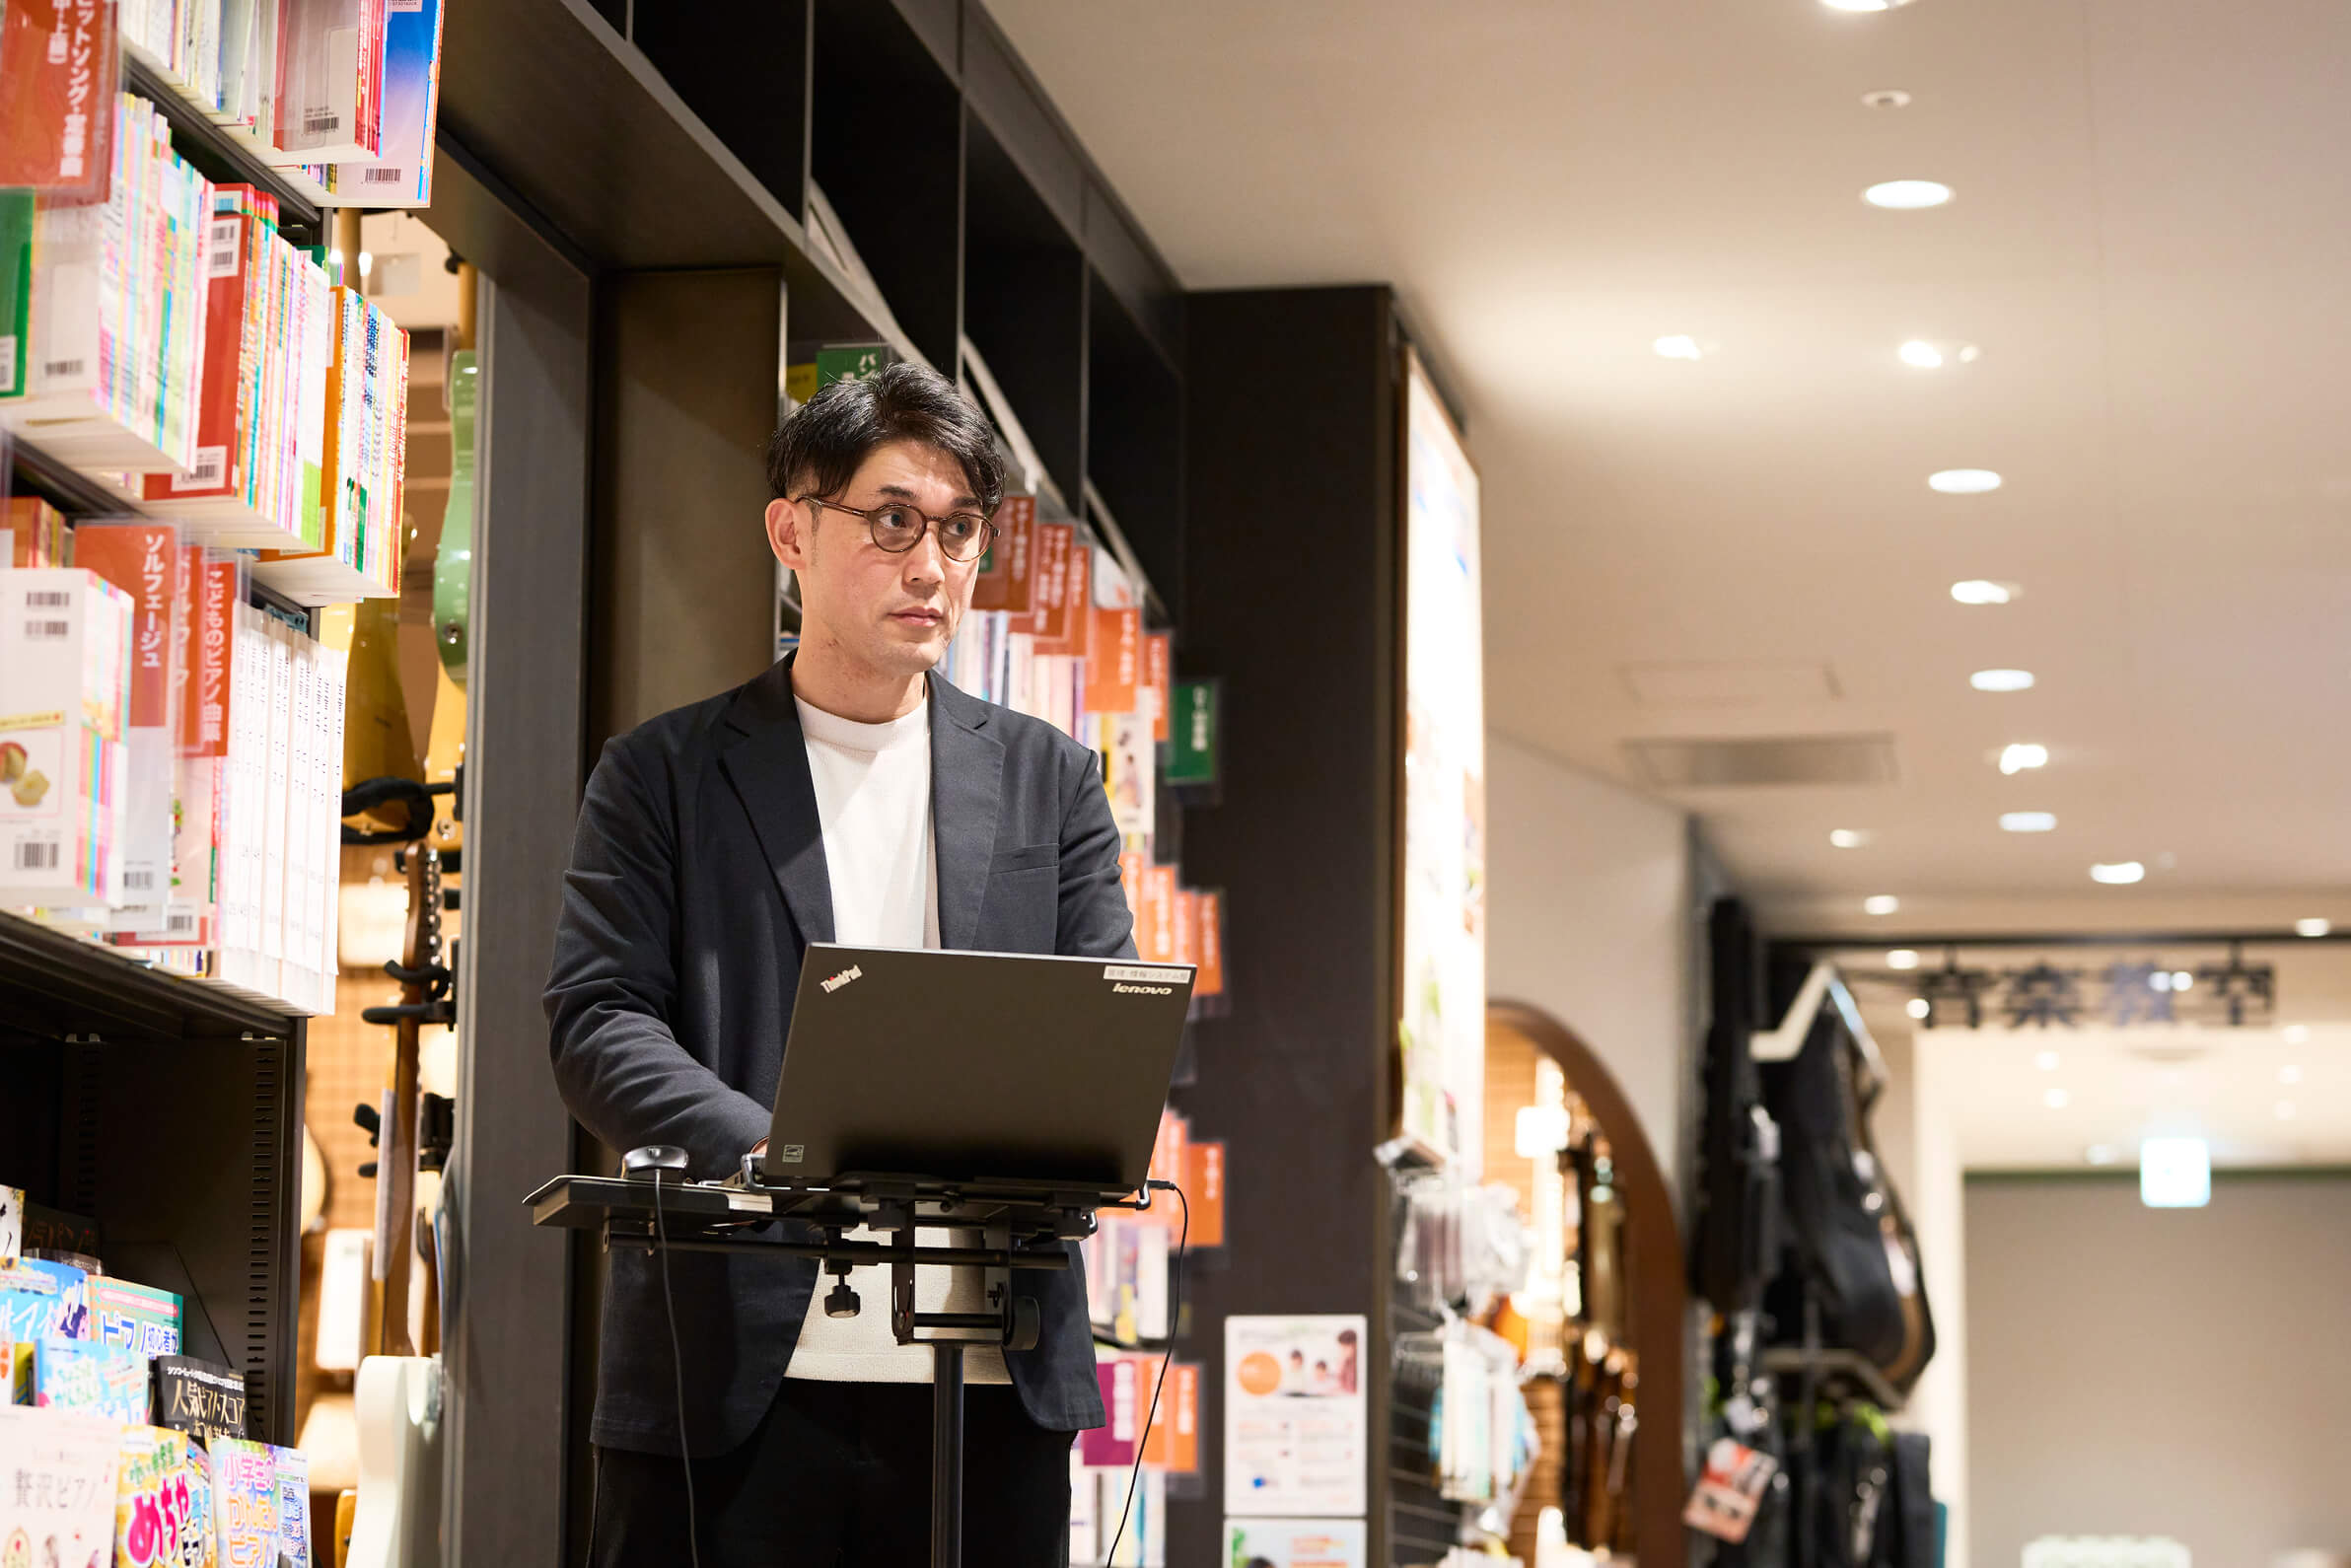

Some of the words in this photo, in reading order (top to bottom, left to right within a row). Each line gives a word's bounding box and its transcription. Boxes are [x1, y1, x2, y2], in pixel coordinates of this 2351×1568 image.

[140, 534, 166, 669] ソルフェージュ
[819, 964, 863, 994] ThinkPad
[1112, 982, 1174, 996] lenovo
